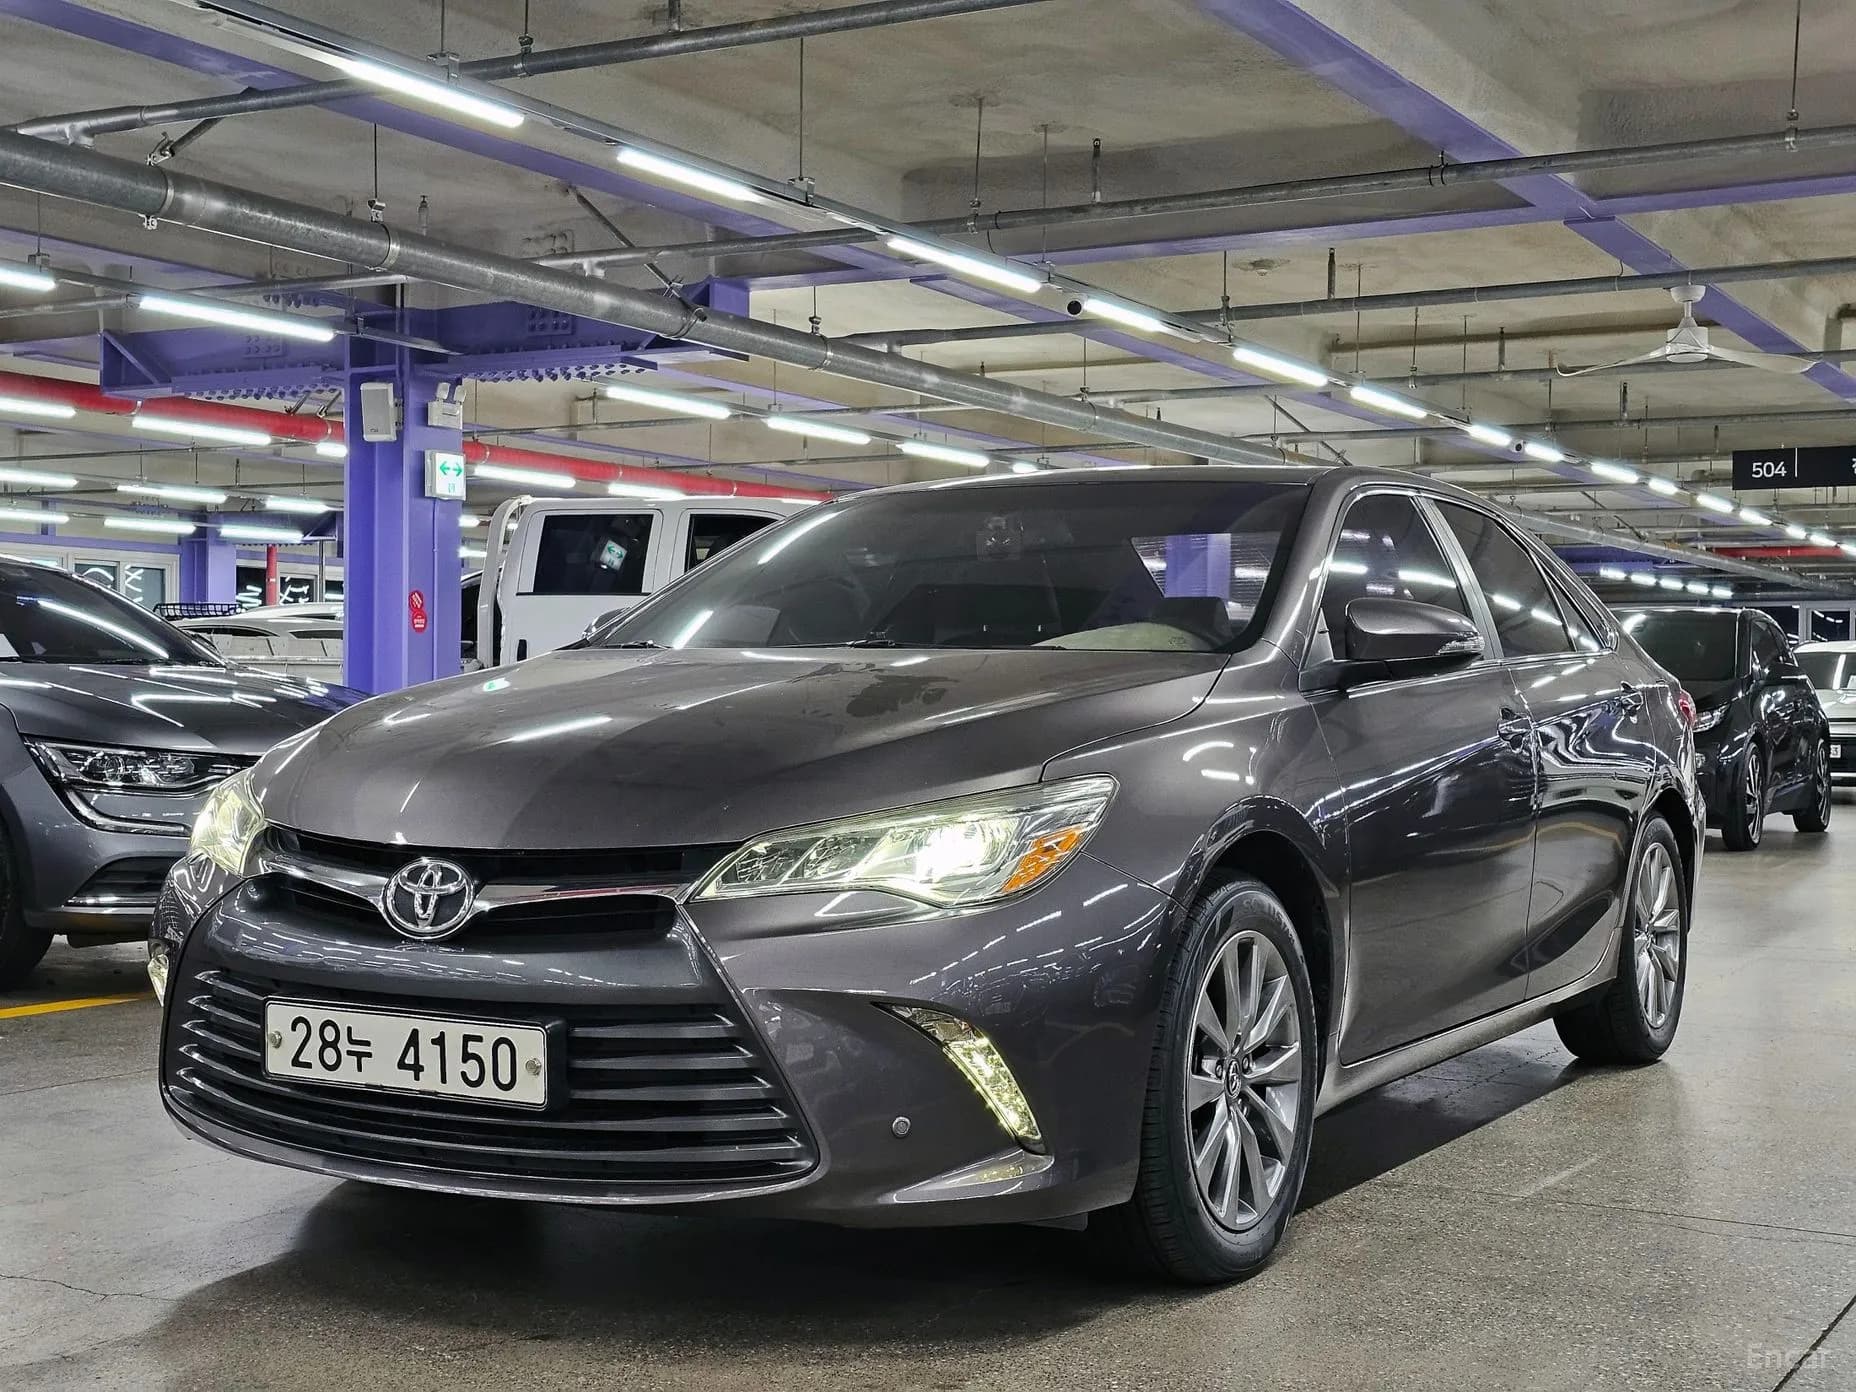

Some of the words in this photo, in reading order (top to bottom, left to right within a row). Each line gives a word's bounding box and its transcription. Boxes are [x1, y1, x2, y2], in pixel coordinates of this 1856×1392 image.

[1751, 461, 1787, 478] 504
[291, 1016, 372, 1073] 28누
[397, 1028, 517, 1092] 4150
